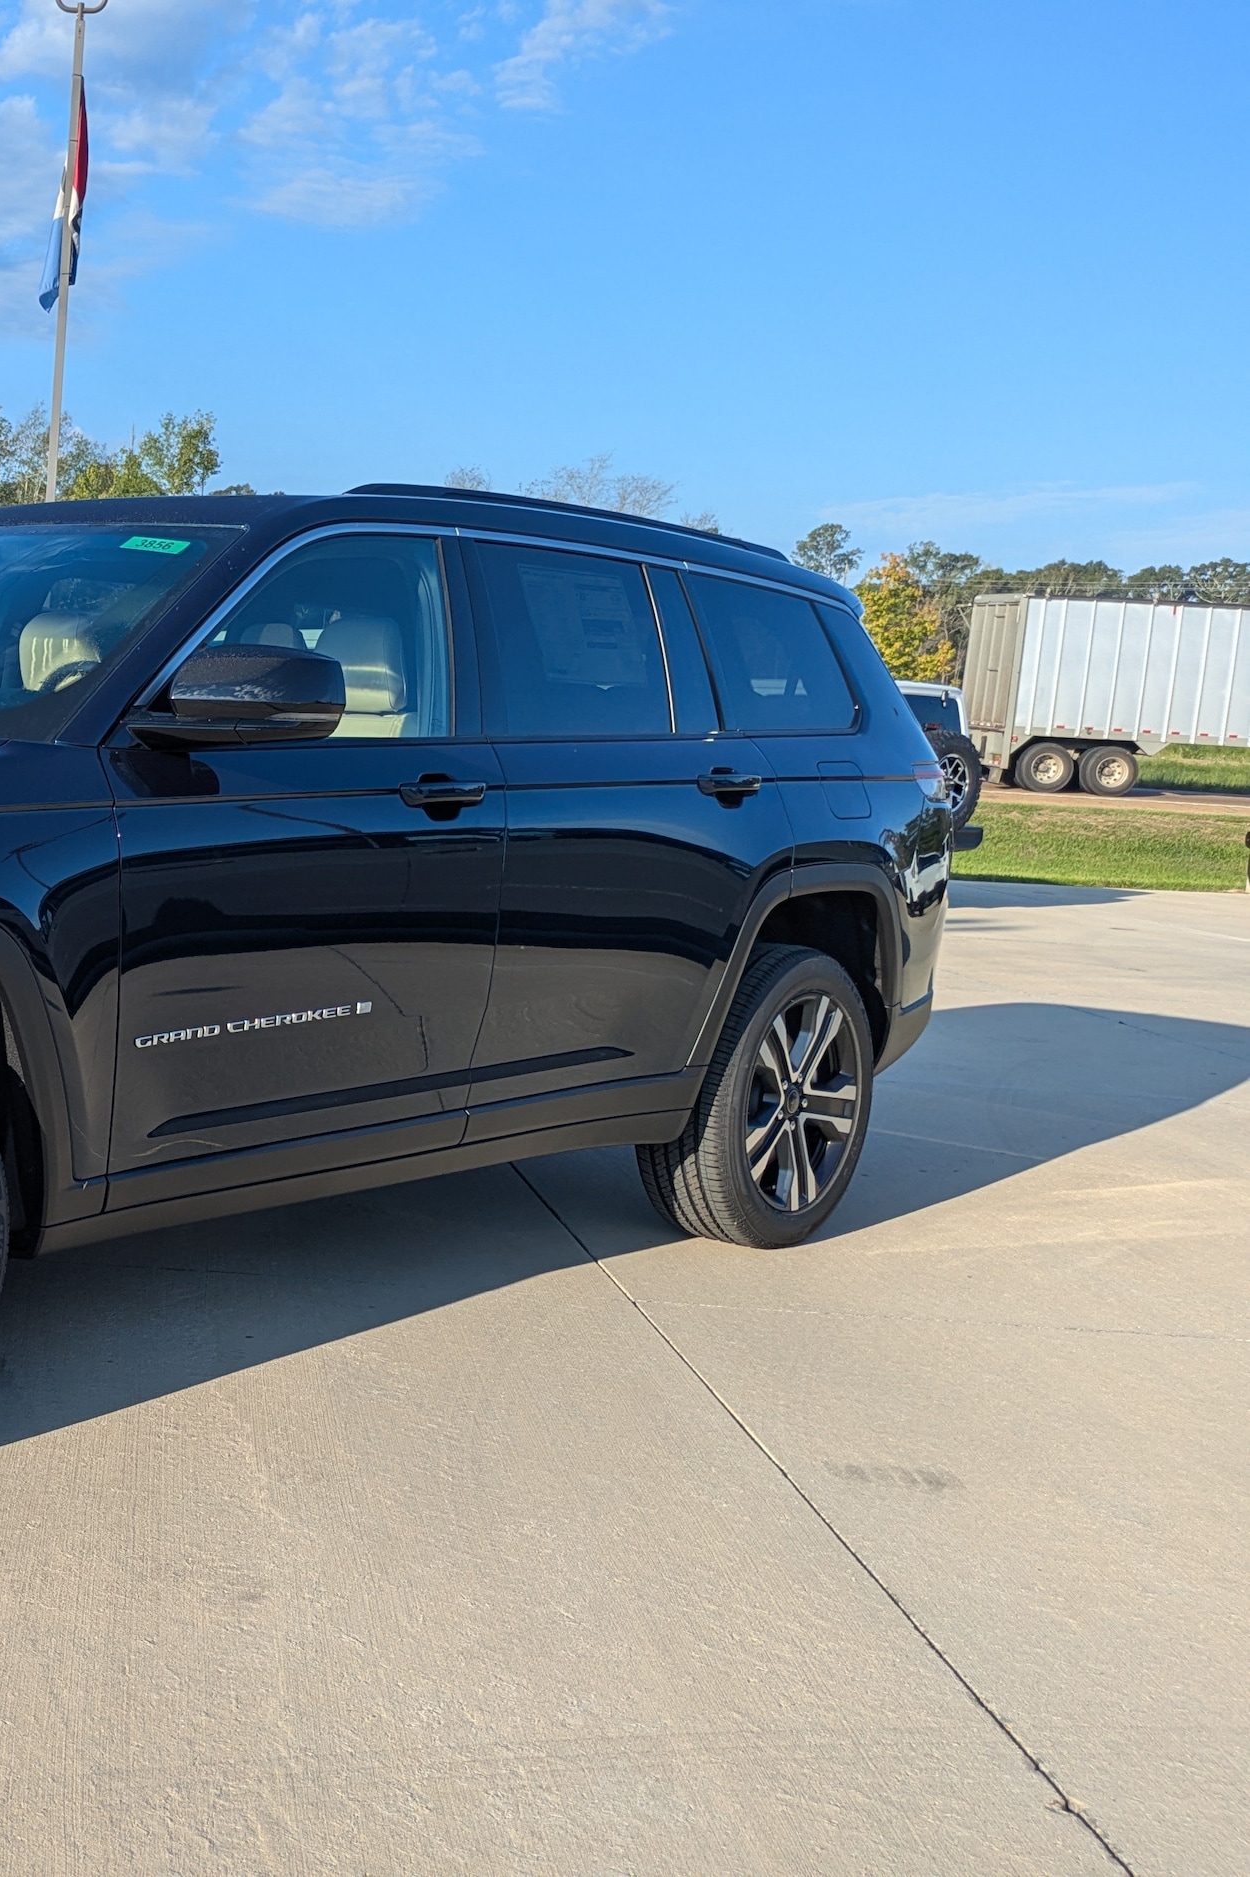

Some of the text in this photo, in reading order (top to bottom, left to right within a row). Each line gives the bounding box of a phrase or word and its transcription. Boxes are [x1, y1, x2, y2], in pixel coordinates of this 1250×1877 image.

[135, 539, 174, 550] 3856
[134, 1004, 352, 1049] GRAND CHEROKEE
